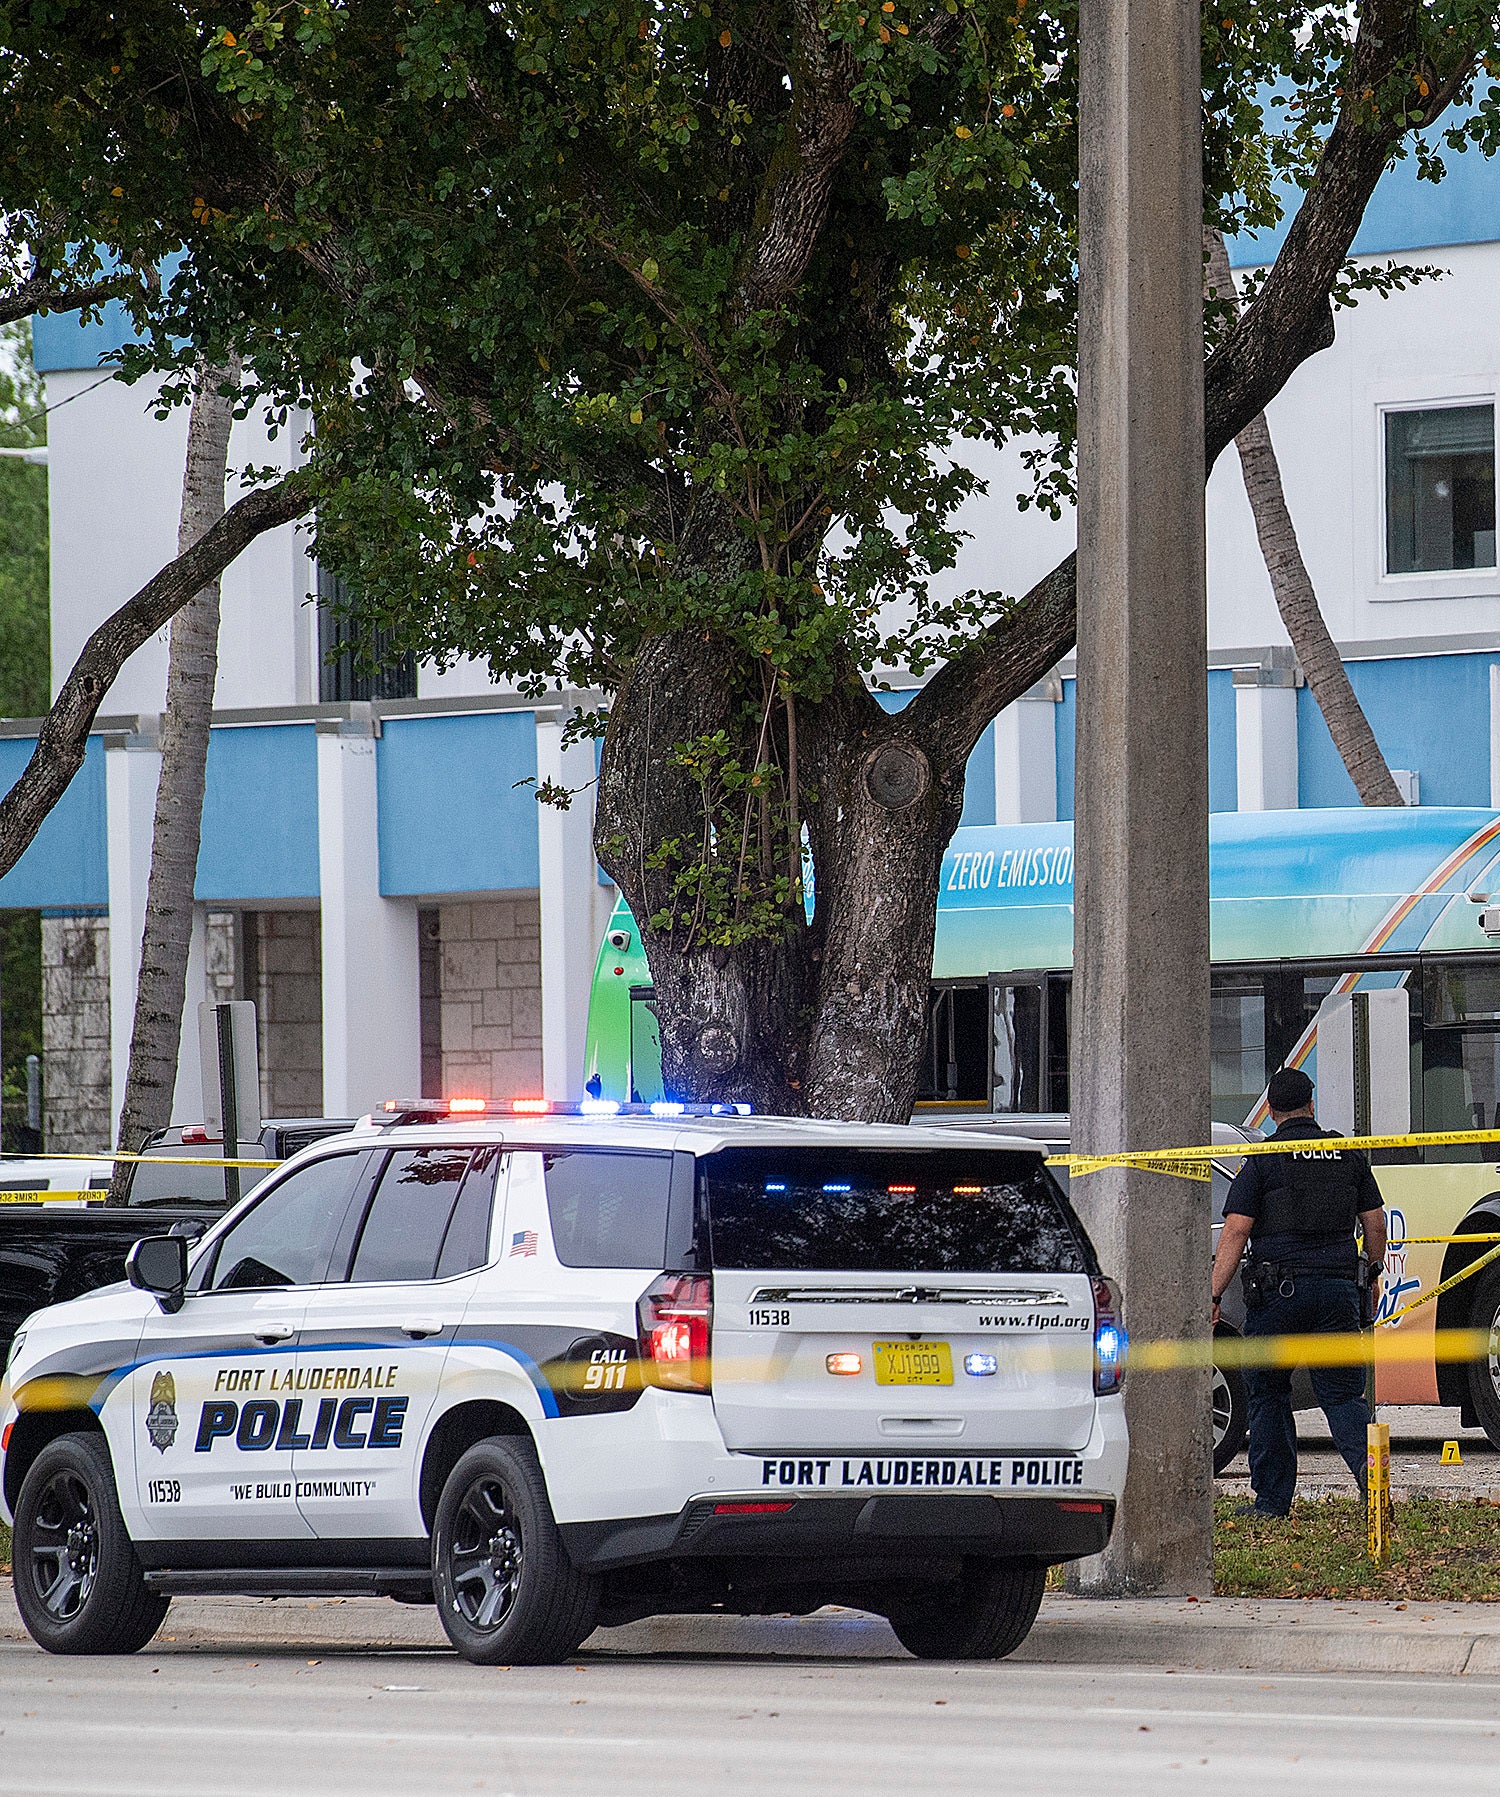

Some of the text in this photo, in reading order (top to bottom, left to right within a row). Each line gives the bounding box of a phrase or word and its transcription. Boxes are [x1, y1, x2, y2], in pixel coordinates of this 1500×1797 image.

[947, 851, 995, 891] ZERO
[1293, 1149, 1342, 1160] POLICE
[1382, 1253, 1406, 1274] NTY
[749, 1310, 1090, 1330] 11538 www.flpd.org
[590, 1349, 628, 1364] CALL
[887, 1354, 940, 1374] XJ1999
[214, 1365, 398, 1392] FORT LAUDERDALE
[583, 1365, 628, 1390] 911
[194, 1396, 409, 1452] POLICE
[1447, 1447, 1455, 1460] 7
[762, 1459, 1083, 1486] FORT LAUDERDALE POLICE
[148, 1480, 181, 1503] 11538
[230, 1481, 377, 1499] "WE BUILD COMMUNITY"
